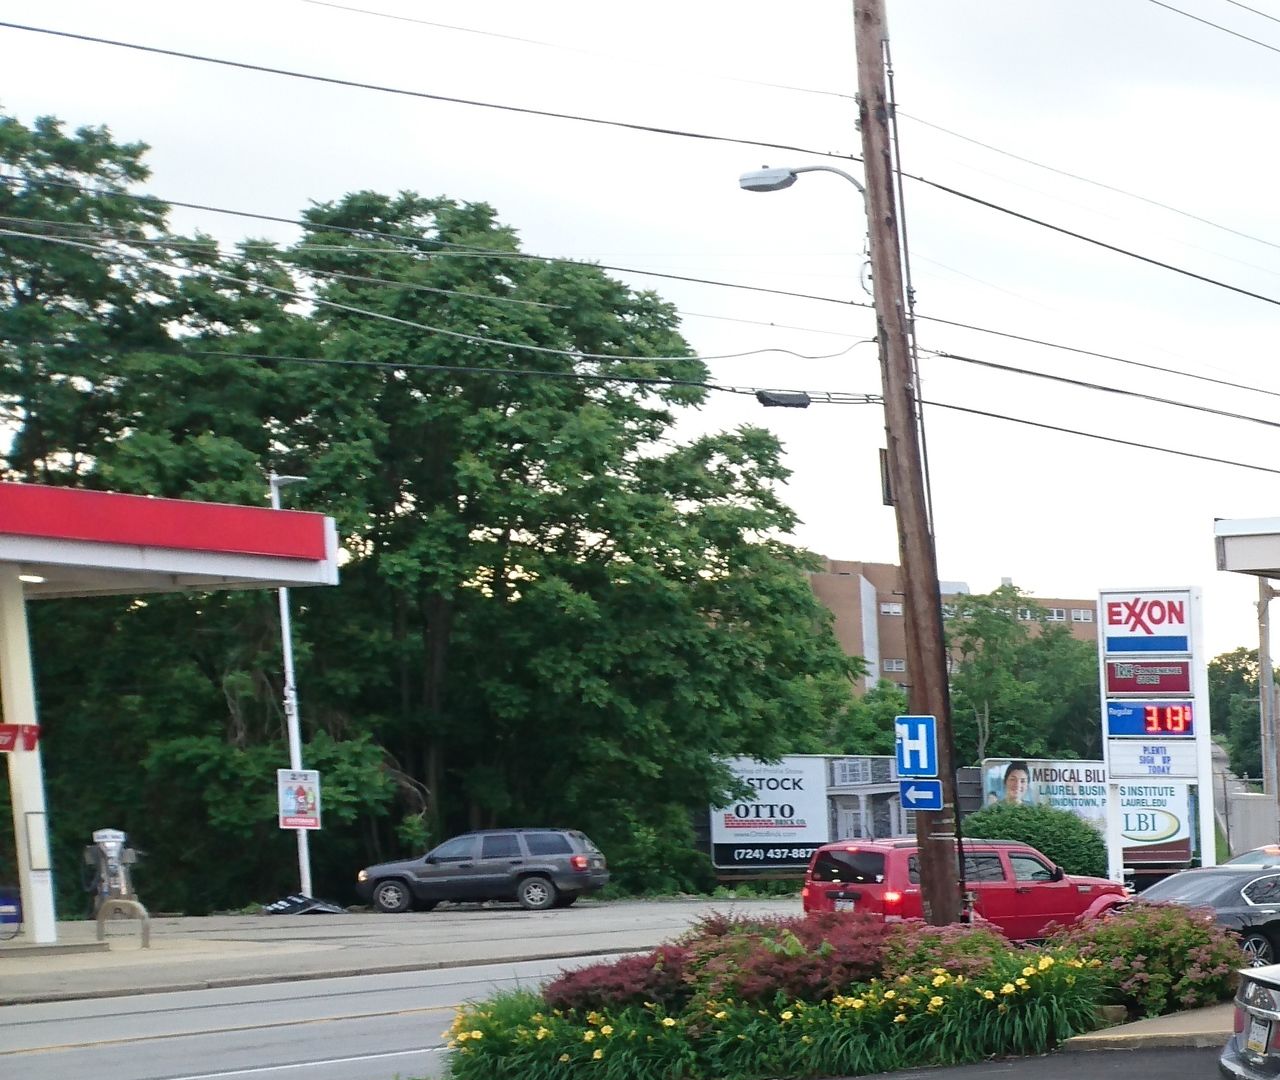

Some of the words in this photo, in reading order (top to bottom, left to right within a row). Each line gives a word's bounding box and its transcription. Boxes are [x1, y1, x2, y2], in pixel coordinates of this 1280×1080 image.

[1107, 597, 1184, 635] EXXON
[1108, 707, 1133, 717] Regular
[902, 723, 929, 769] H
[1143, 746, 1167, 755] PLENTI
[1139, 756, 1155, 765] SIGN
[1161, 755, 1171, 765] UP
[1032, 768, 1083, 783] MEDICAL
[1148, 765, 1171, 775] TODAY
[747, 777, 804, 791] STOCK
[1039, 785, 1077, 796] LAUREL
[1127, 786, 1175, 797] INSTITUTE
[1121, 798, 1167, 808] LAUREL.EDU
[734, 803, 794, 819] OTTO
[1123, 813, 1158, 832] LBI
[734, 849, 764, 860] (724)
